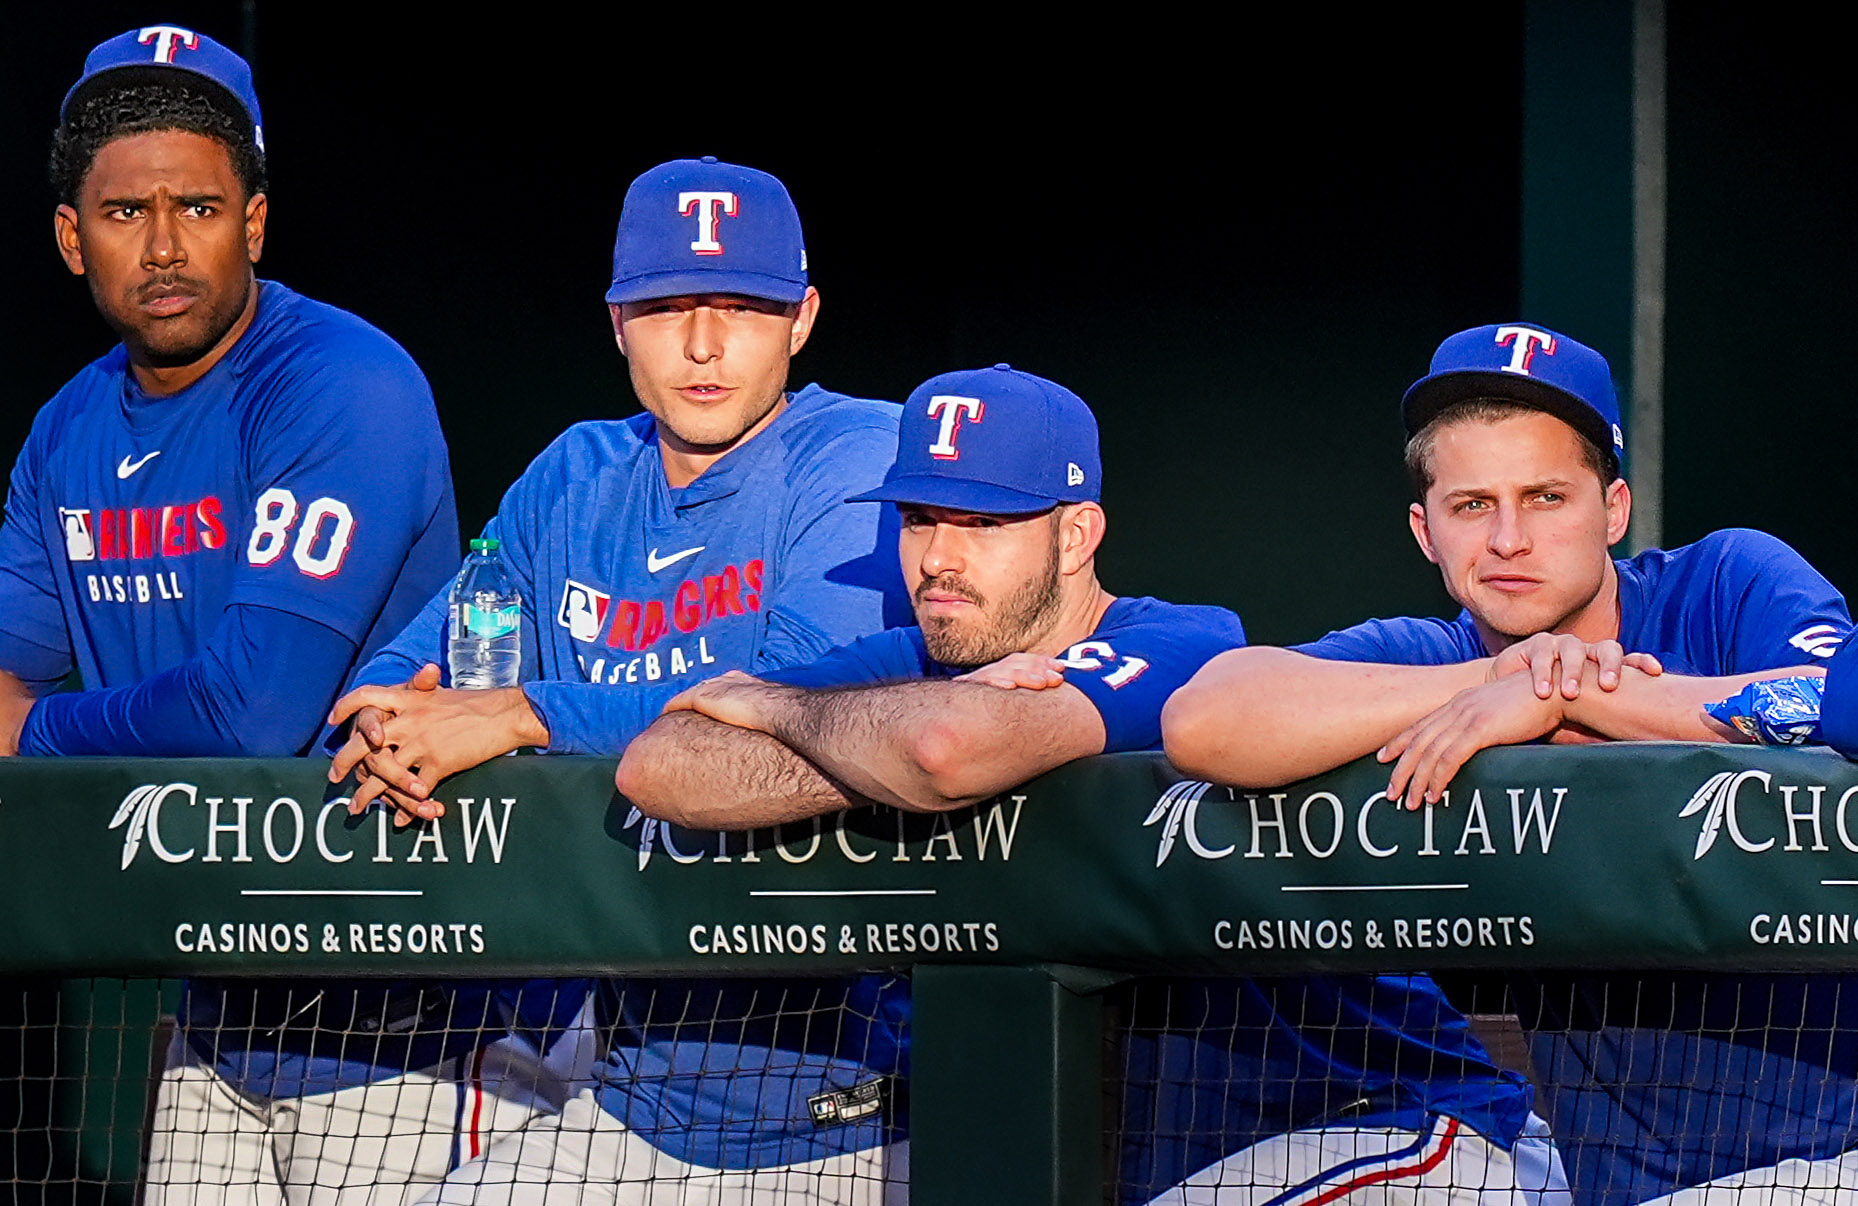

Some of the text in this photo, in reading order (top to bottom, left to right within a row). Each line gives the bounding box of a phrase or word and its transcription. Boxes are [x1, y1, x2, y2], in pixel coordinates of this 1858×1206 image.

[137, 26, 199, 64] T
[678, 191, 738, 256] T
[1494, 326, 1556, 376] T
[927, 396, 985, 461] T
[247, 488, 355, 580] 80
[175, 923, 485, 954] CASINOS & RESORTS
[689, 922, 999, 954] CASINOS & RESORTS
[1214, 917, 1534, 949] CASINOS & RESORTS
[1750, 914, 1858, 944] CASIN
